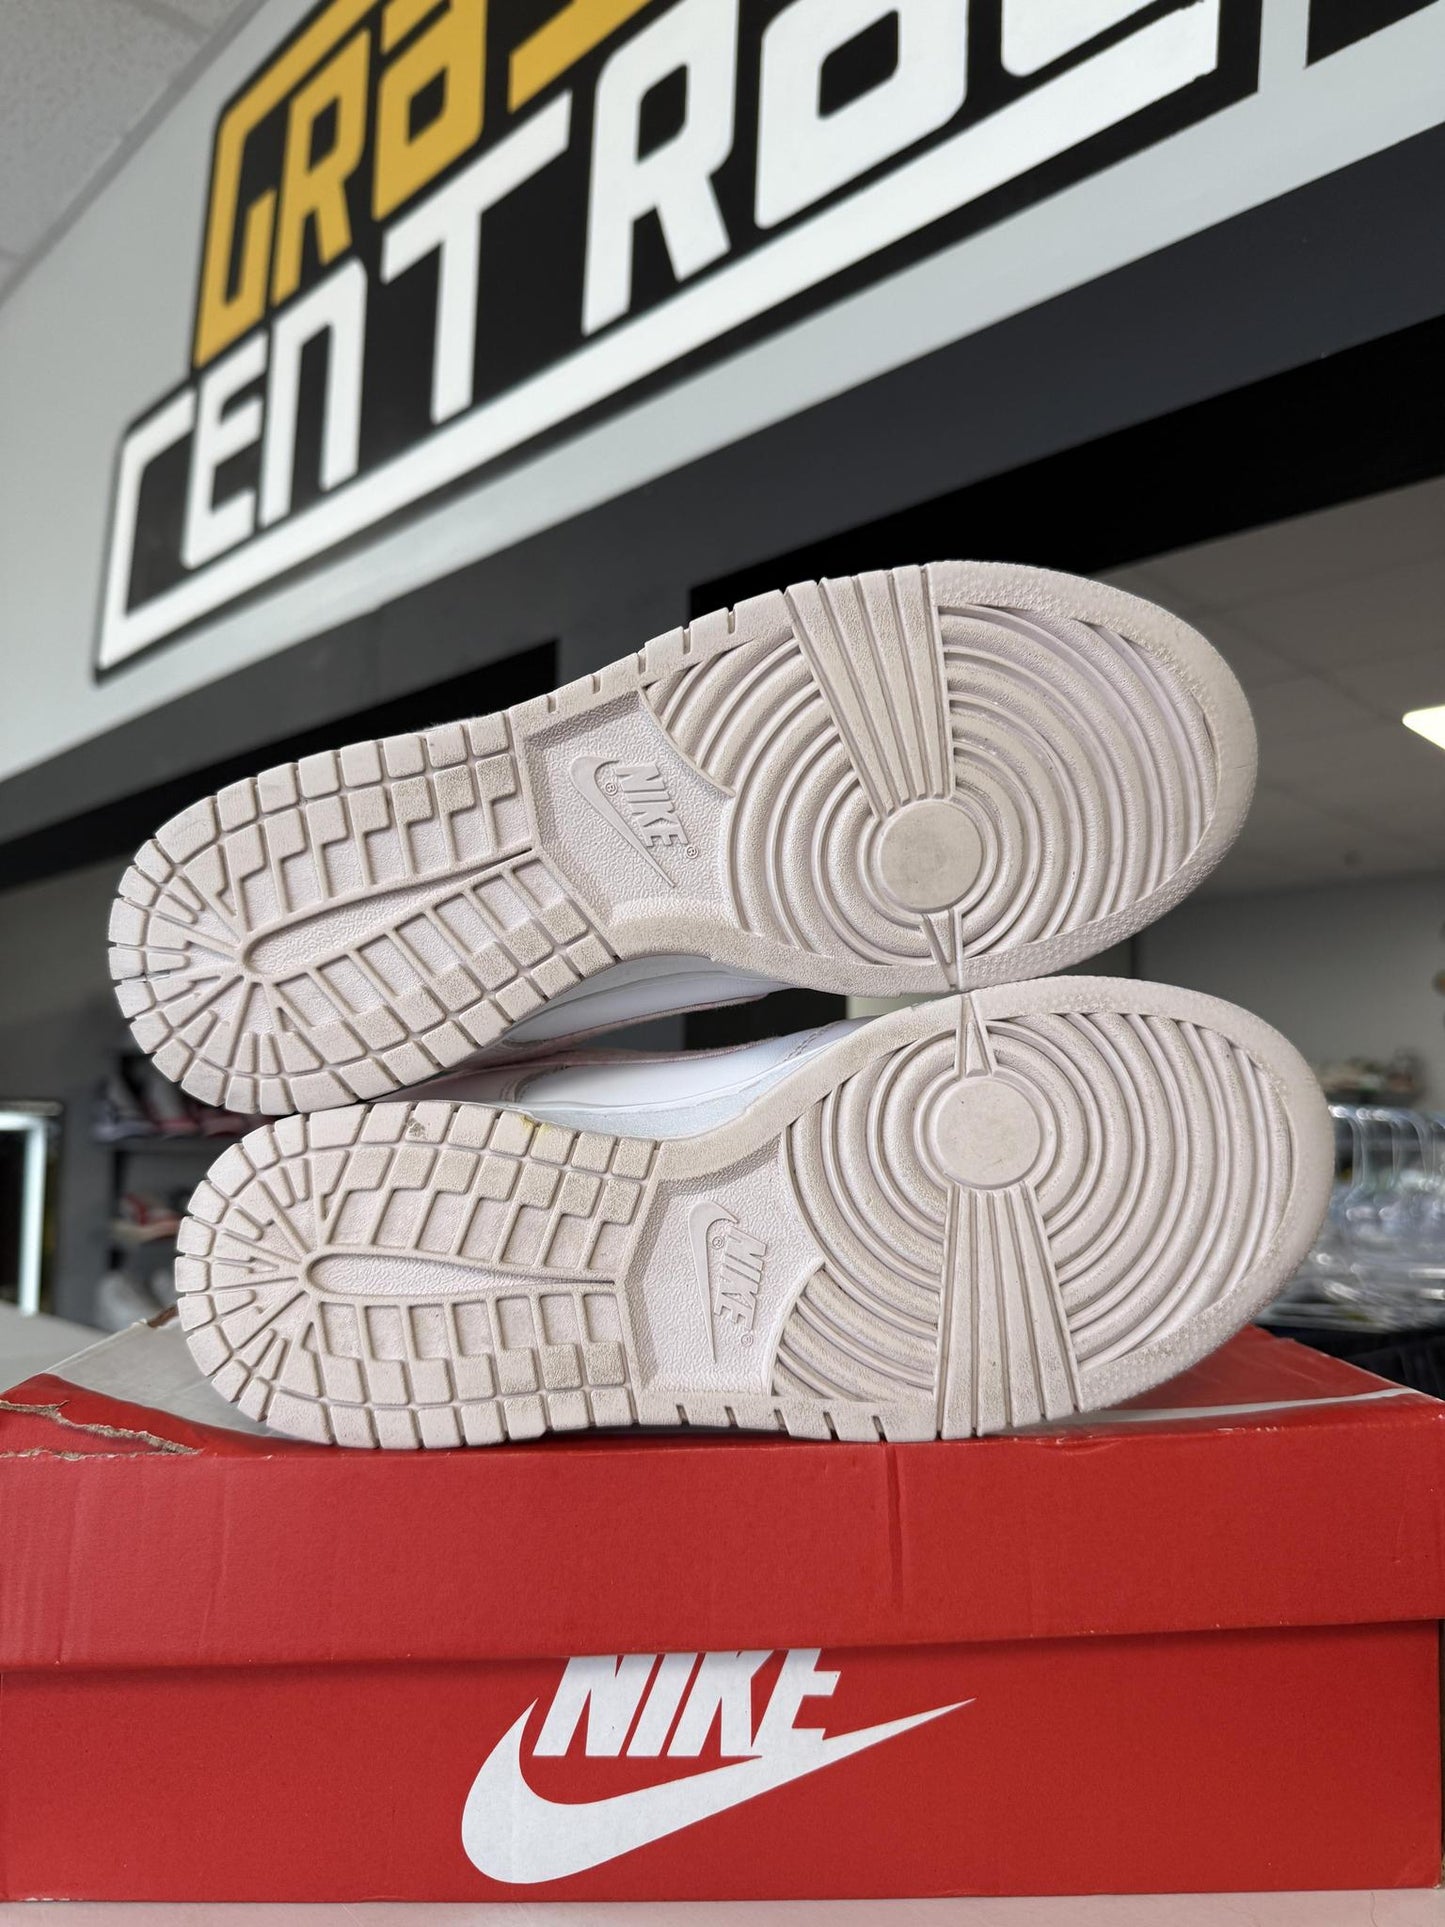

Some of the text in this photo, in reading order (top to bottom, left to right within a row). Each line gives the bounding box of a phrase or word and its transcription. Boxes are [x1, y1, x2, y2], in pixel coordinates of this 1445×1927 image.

[614, 763, 689, 848] NIKE
[714, 1226, 767, 1331] NIKE
[532, 1648, 841, 1757] NIKE
